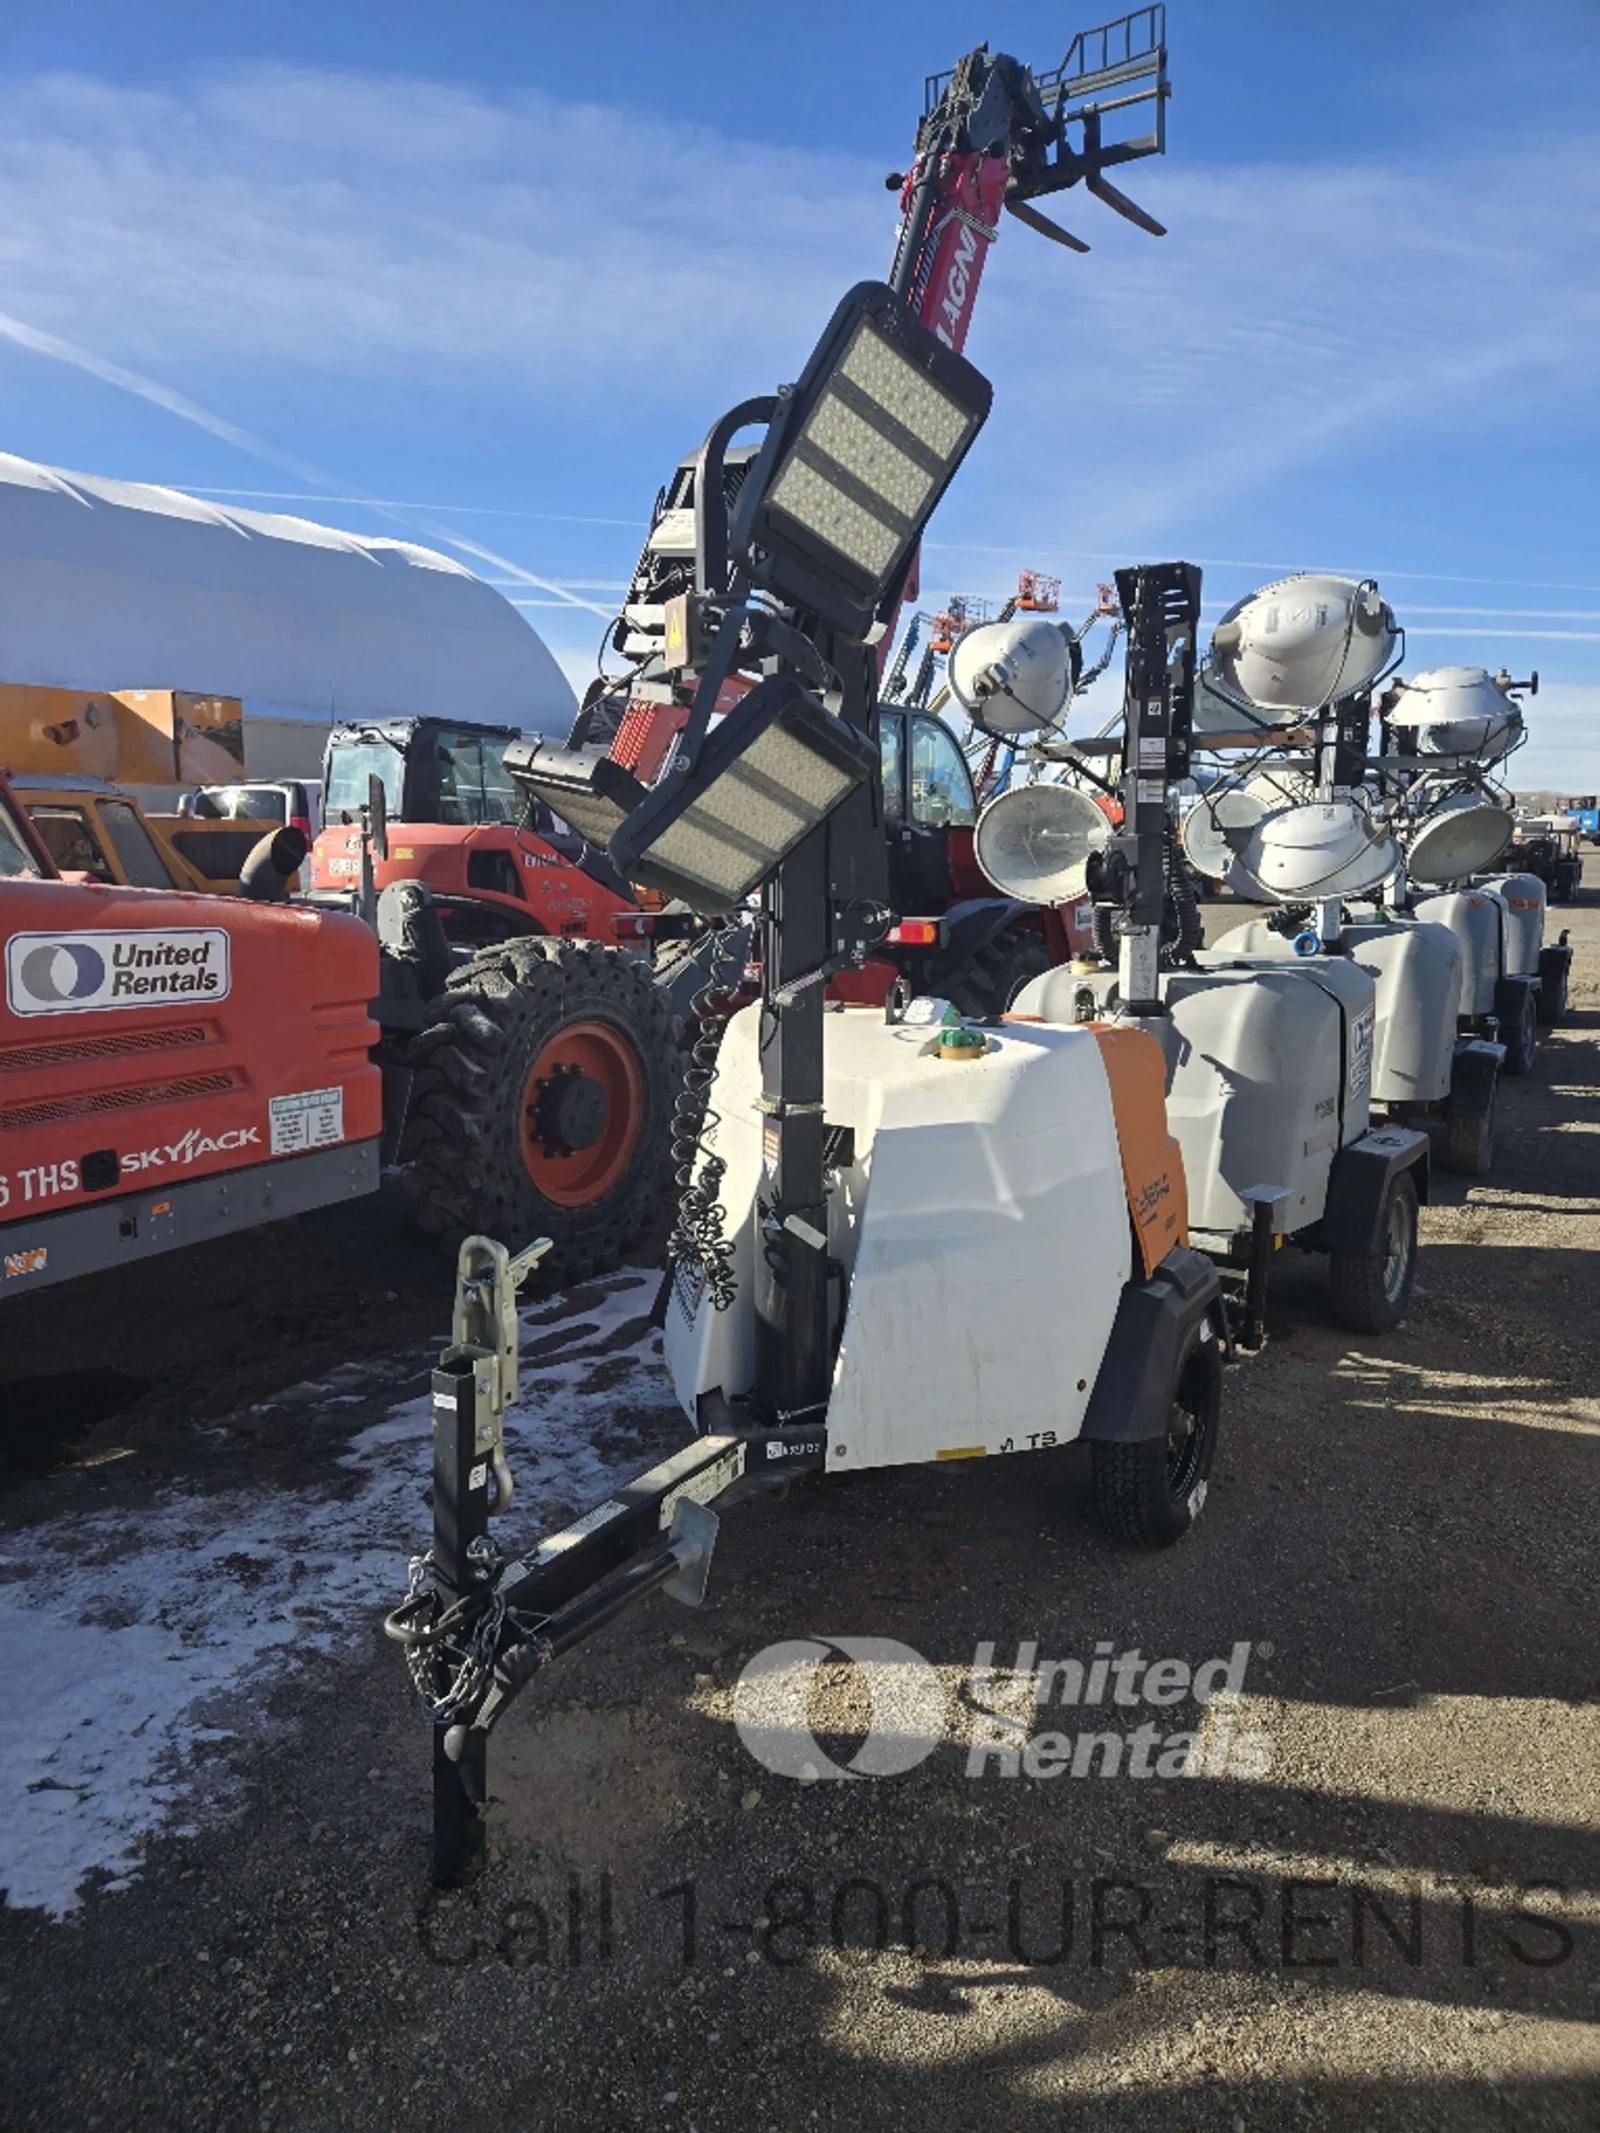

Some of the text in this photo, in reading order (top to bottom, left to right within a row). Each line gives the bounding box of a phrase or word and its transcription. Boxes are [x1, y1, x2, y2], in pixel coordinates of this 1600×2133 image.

[111, 941, 211, 968] United
[111, 966, 218, 997] Rentals
[120, 1127, 262, 1173] SKYJACK
[17, 1160, 79, 1201] THS
